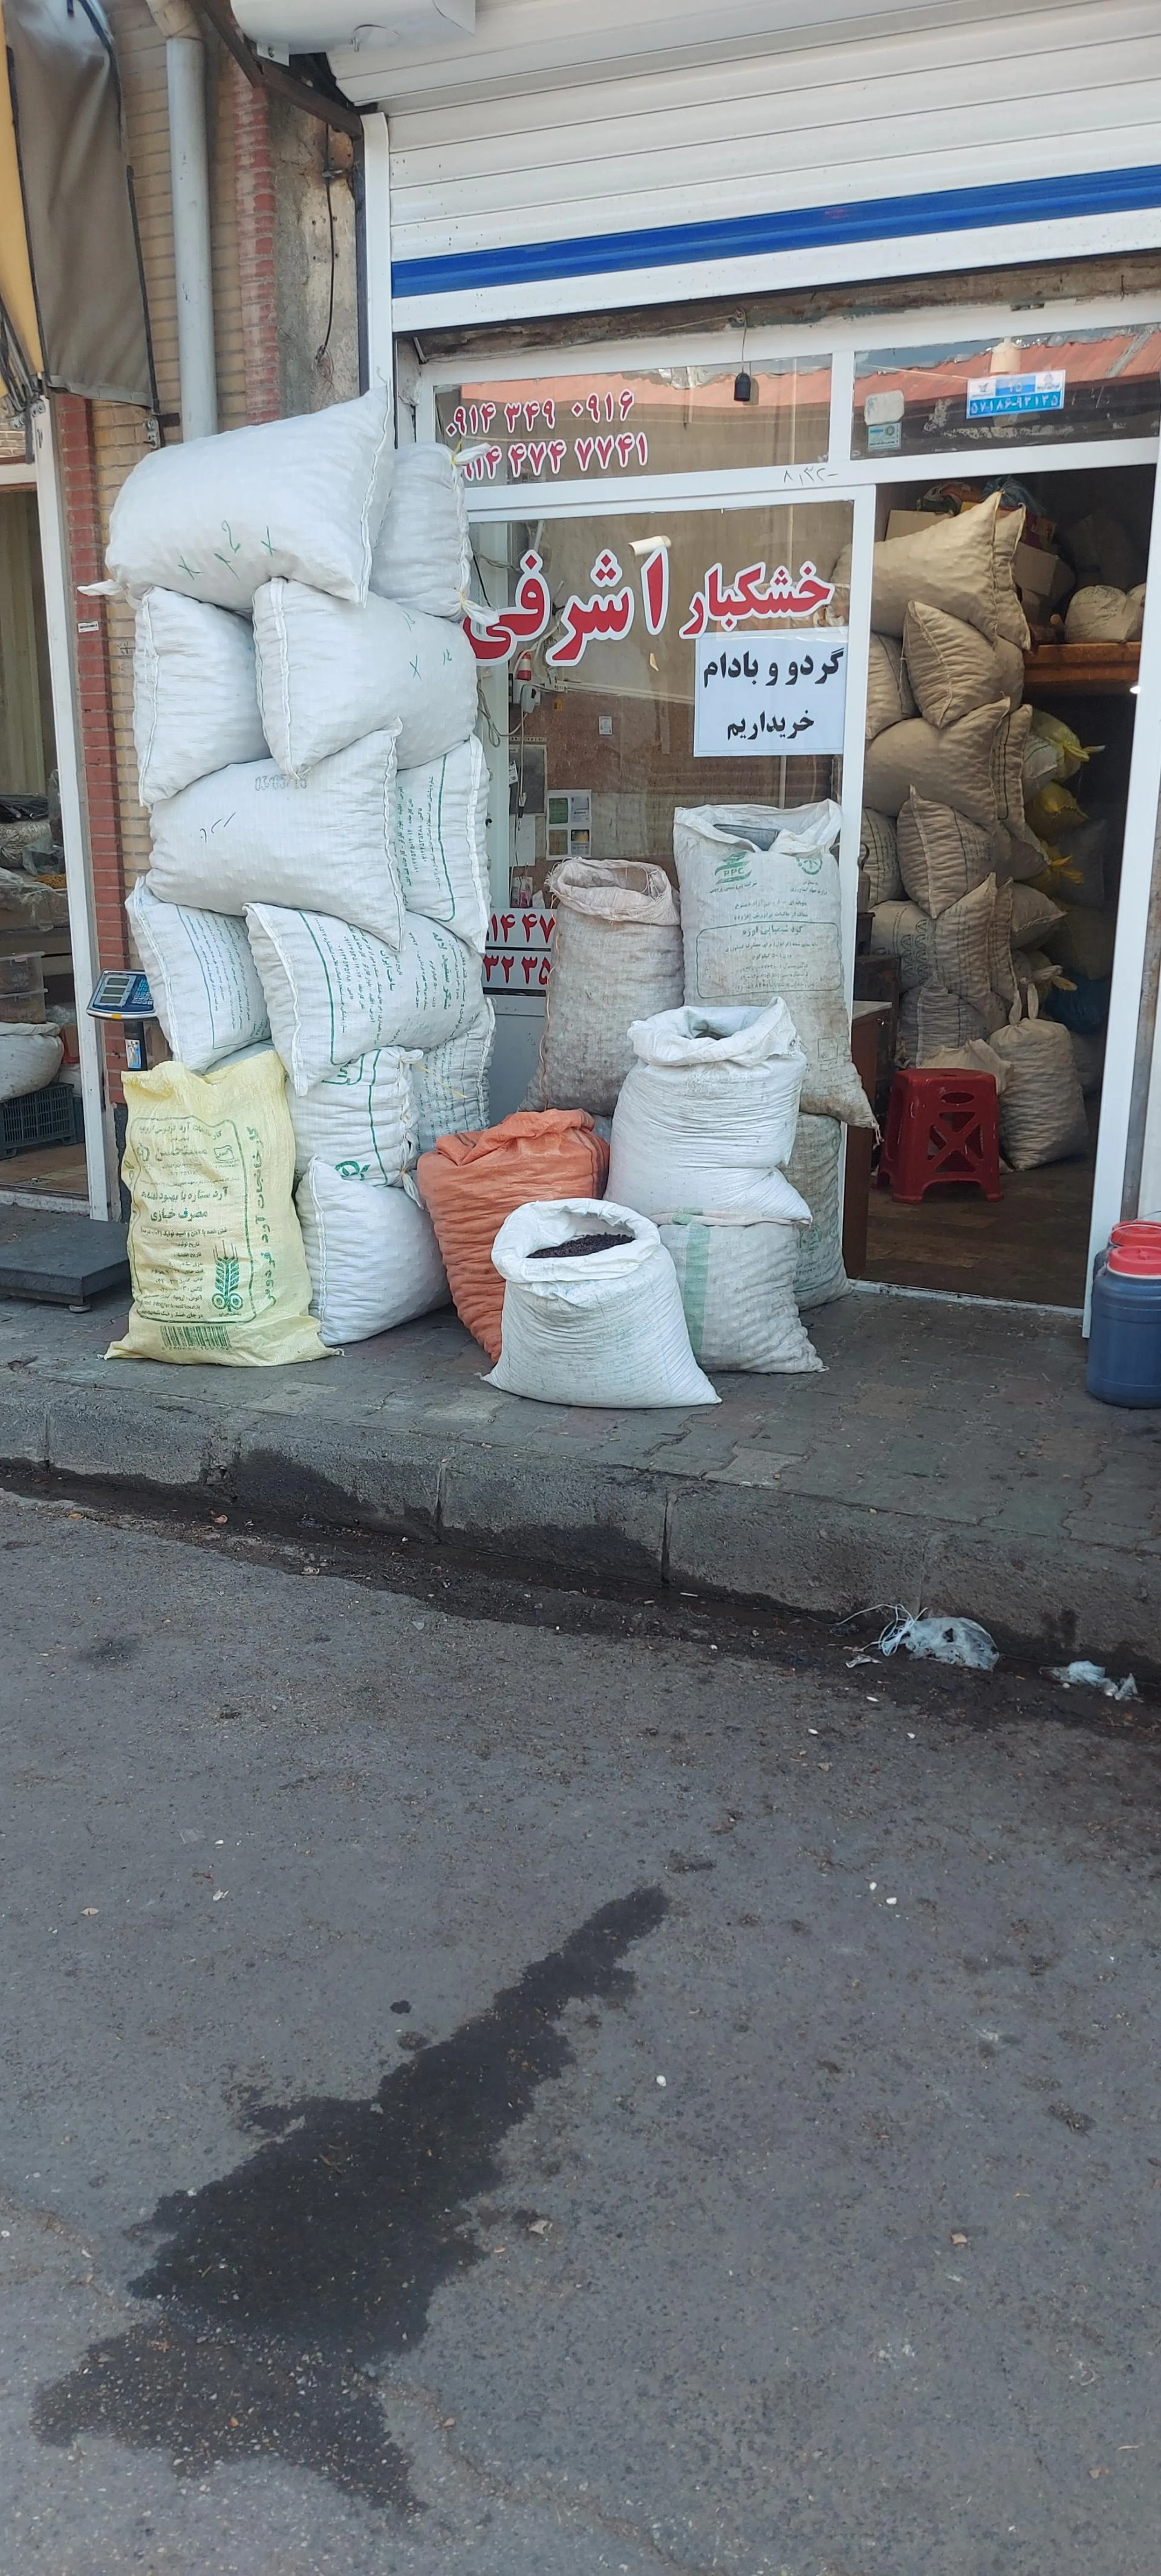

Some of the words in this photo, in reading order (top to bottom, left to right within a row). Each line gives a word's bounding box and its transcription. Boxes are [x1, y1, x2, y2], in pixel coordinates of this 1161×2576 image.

[446, 402, 496, 437] ۰۹۱۴
[504, 398, 555, 433] ۳۴۹
[572, 388, 635, 423] ۰۹۱۶
[508, 439, 567, 478] ۴۷۴
[574, 431, 648, 472] ۷۷۴۱
[463, 545, 669, 666] اشرفی
[680, 561, 834, 639] خشکبار
[703, 651, 758, 688] بادام
[766, 662, 778, 686] و
[785, 647, 844, 685] گردو
[727, 709, 815, 741] خریداریم
[724, 867, 744, 877] PPC
[380, 951, 392, 968] ایران
[387, 969, 395, 991] ساخت
[151, 1208, 175, 1222] خبازی
[178, 1208, 208, 1221] مصرف
